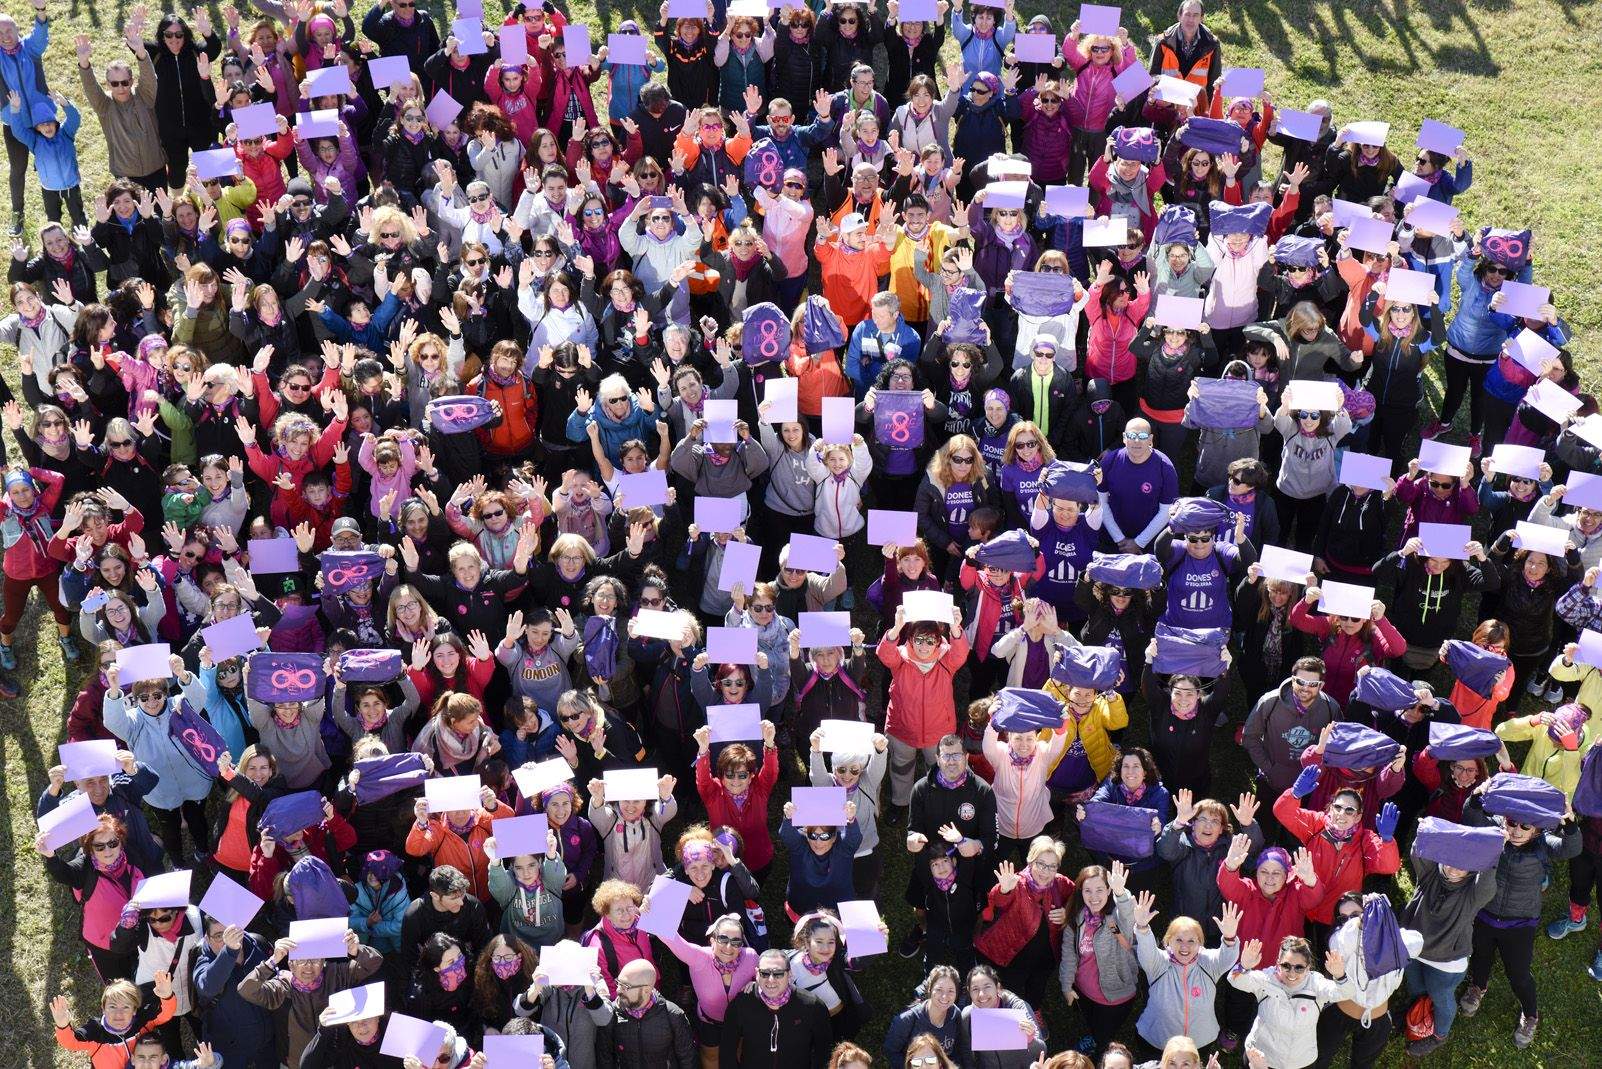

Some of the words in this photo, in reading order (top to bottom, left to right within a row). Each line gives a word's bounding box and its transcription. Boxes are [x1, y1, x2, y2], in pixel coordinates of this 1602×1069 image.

[760, 151, 778, 186] 8
[760, 319, 779, 357] 8
[891, 411, 910, 443] 8
[983, 444, 1006, 456] DONE
[947, 490, 973, 500] DONES
[1186, 573, 1212, 582] DONES
[521, 661, 561, 681] LONDON
